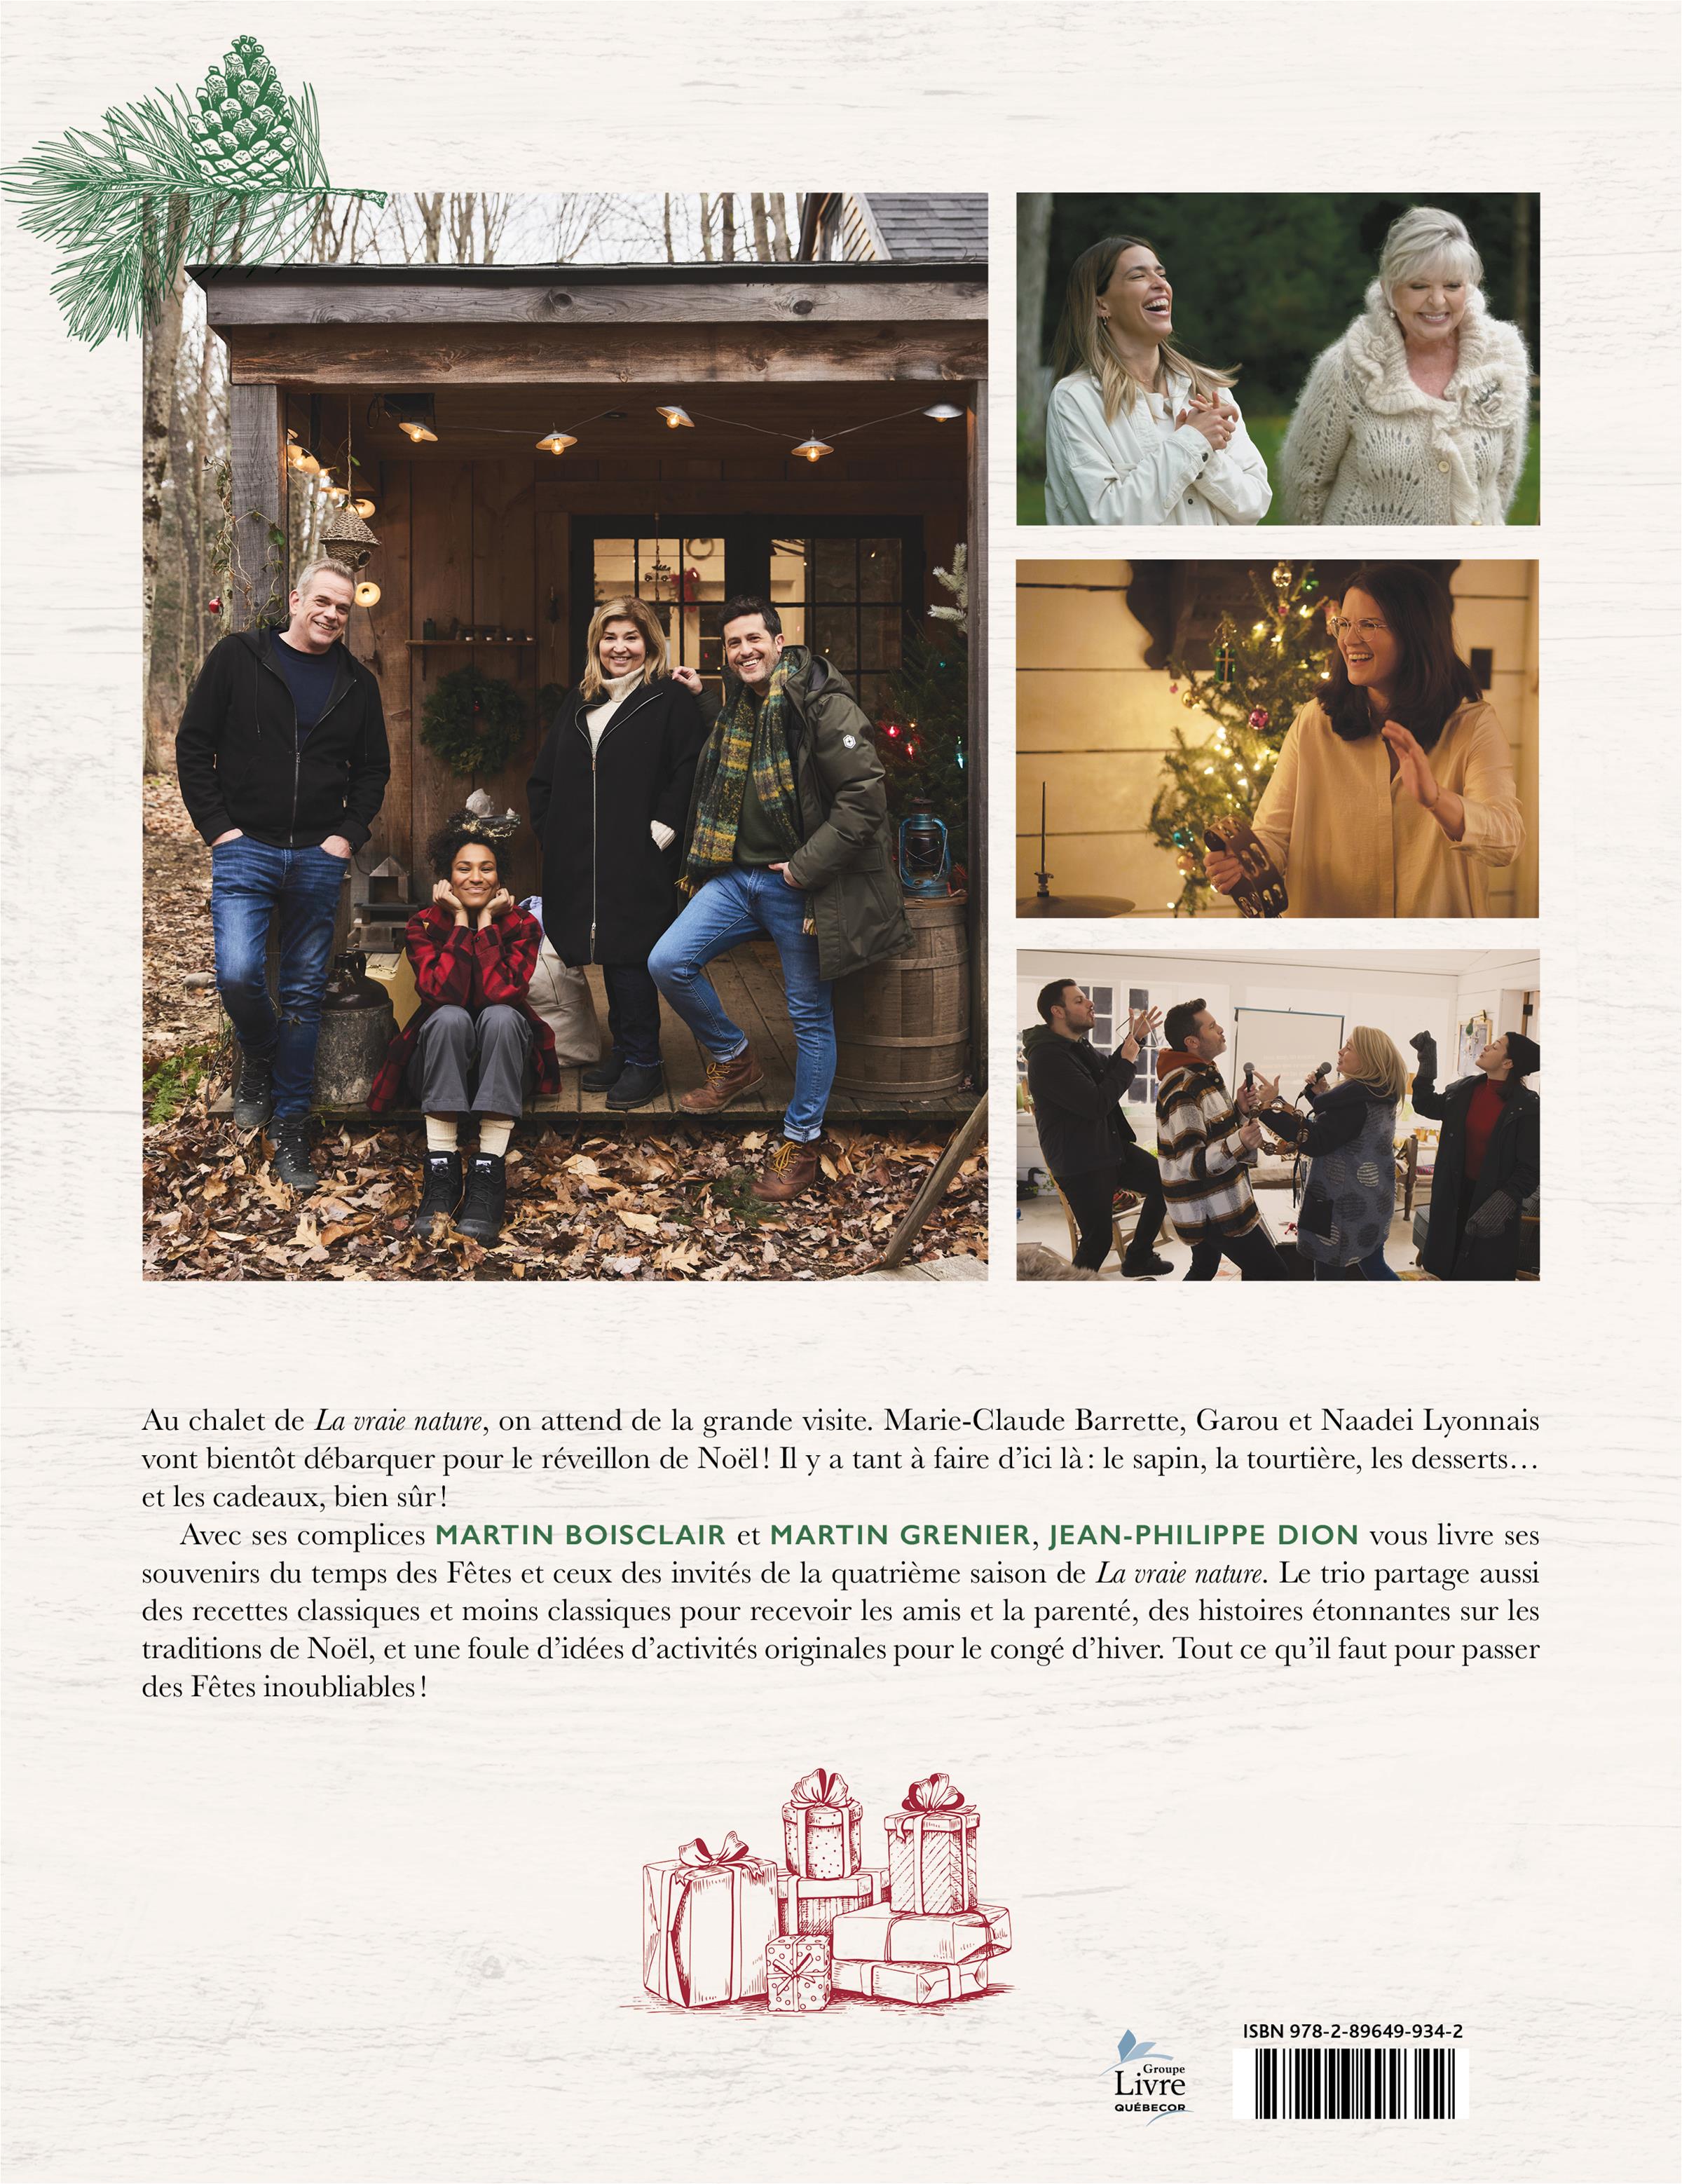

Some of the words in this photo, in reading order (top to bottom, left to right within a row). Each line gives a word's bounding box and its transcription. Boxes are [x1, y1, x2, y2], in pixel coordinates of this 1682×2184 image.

[141, 1408, 179, 1431] Au
[189, 1408, 266, 1431] chalet
[275, 1408, 304, 1431] de
[313, 1408, 345, 1431] La
[354, 1407, 406, 1431] vraie
[414, 1412, 489, 1436] nature,
[499, 1416, 531, 1431] on
[541, 1408, 622, 1431] attend
[631, 1408, 661, 1431] de
[671, 1408, 694, 1431] la
[703, 1408, 793, 1438] grande
[802, 1408, 873, 1431] visite.
[884, 1407, 1065, 1431] Marie-Claude
[1074, 1408, 1186, 1436] Barrette,
[1196, 1407, 1279, 1431] Garou
[1289, 1413, 1313, 1431] et
[1320, 1408, 1414, 1431] Naadei
[1423, 1408, 1540, 1438] Lyonnais
[141, 1451, 198, 1469] vont
[205, 1446, 296, 1469] bientôt
[304, 1446, 436, 1477] débarquer
[442, 1454, 504, 1477] pour
[512, 1446, 533, 1469] le
[542, 1446, 650, 1469] réveillon
[659, 1446, 689, 1469] de
[779, 1446, 798, 1469] Il
[805, 1454, 821, 1477] y
[829, 1454, 844, 1469] a
[852, 1451, 903, 1469] tant
[910, 1446, 926, 1469] à
[934, 1446, 990, 1469] faire
[999, 1446, 1052, 1469] d’ici
[1103, 1446, 1124, 1469] le
[1133, 1446, 1207, 1477] sapin,
[1215, 1446, 1239, 1469] la
[1247, 1446, 1362, 1475] tourtière,
[1371, 1446, 1403, 1469] les
[1411, 1446, 1537, 1469] desserts…
[142, 1489, 165, 1508] et
[173, 1485, 205, 1508] les
[213, 1484, 325, 1513] cadeaux,
[334, 1484, 389, 1508] bien
[179, 1522, 242, 1545] Avec
[252, 1530, 287, 1545] ses
[297, 1522, 425, 1553] complices
[437, 1524, 553, 1545] MARTIN
[566, 1524, 725, 1545] BOISCLAIR
[737, 1527, 761, 1545] et
[771, 1524, 887, 1545] MARTIN
[901, 1524, 1039, 1551] GRENIER,
[1048, 1524, 1264, 1551] JEAN-PHILIPPE
[1278, 1524, 1358, 1545] DION
[1369, 1530, 1428, 1545] vous
[1437, 1522, 1493, 1545] livre
[1505, 1530, 1540, 1545] ses
[142, 1560, 260, 1584] souvenirs
[270, 1560, 302, 1584] du
[311, 1566, 387, 1591] temps
[397, 1560, 437, 1584] des
[446, 1561, 512, 1584] Fêtes
[521, 1566, 545, 1584] et
[553, 1569, 613, 1584] ceux
[622, 1560, 662, 1584] des
[671, 1560, 751, 1584] invités
[760, 1560, 791, 1584] de
[800, 1561, 823, 1583] la
[832, 1560, 961, 1591] quatrième
[971, 1560, 1047, 1584] saison
[1057, 1560, 1086, 1584] de
[1095, 1561, 1126, 1583] La
[1135, 1560, 1187, 1584] vraie
[1195, 1564, 1268, 1584] nature.
[1279, 1561, 1311, 1584] Le
[1320, 1560, 1365, 1584] trio
[1374, 1566, 1470, 1591] partage
[1480, 1560, 1540, 1584] aussi
[142, 1598, 183, 1621] des
[192, 1603, 288, 1621] recettes
[297, 1598, 420, 1629] classiques
[430, 1603, 453, 1621] et
[462, 1598, 538, 1621] moins
[548, 1598, 671, 1629] classiques
[679, 1606, 741, 1629] pour
[750, 1598, 852, 1621] recevoir
[861, 1598, 893, 1621] les
[903, 1598, 961, 1621] amis
[970, 1603, 994, 1621] et
[1002, 1598, 1025, 1621] la
[1034, 1598, 1138, 1629] parenté,
[1149, 1598, 1189, 1621] des
[1198, 1598, 1303, 1621] histoires
[1313, 1598, 1450, 1621] étonnantes
[1461, 1606, 1499, 1621] sur
[1507, 1598, 1540, 1621] les
[142, 1636, 262, 1660] traditions
[270, 1636, 300, 1660] de
[307, 1636, 375, 1665] Noël,
[383, 1641, 406, 1660] et
[413, 1644, 460, 1660] une
[467, 1636, 529, 1660] foule
[537, 1636, 624, 1660] d’idées
[631, 1636, 757, 1660] d’activités
[765, 1636, 887, 1667] originales
[893, 1644, 955, 1667] pour
[961, 1637, 982, 1660] le
[990, 1637, 1065, 1667] congé
[1072, 1636, 1163, 1660] d’hiver.
[1172, 1637, 1233, 1660] Tout
[1240, 1644, 1266, 1660] ce
[1275, 1636, 1331, 1667] qu’il
[1338, 1636, 1388, 1660] faut
[1394, 1644, 1456, 1667] pour
[1461, 1644, 1540, 1667] passer
[142, 1674, 183, 1698] des
[191, 1674, 256, 1698] Fêtes
[1243, 2023, 1284, 2039] ISBN
[1290, 2023, 1463, 2038] 978-2-89649-934-2
[1114, 2070, 1186, 2096] Livre
[1142, 2063, 1186, 2076] Groupe
[1114, 2102, 1186, 2112] QUÉBECOR
